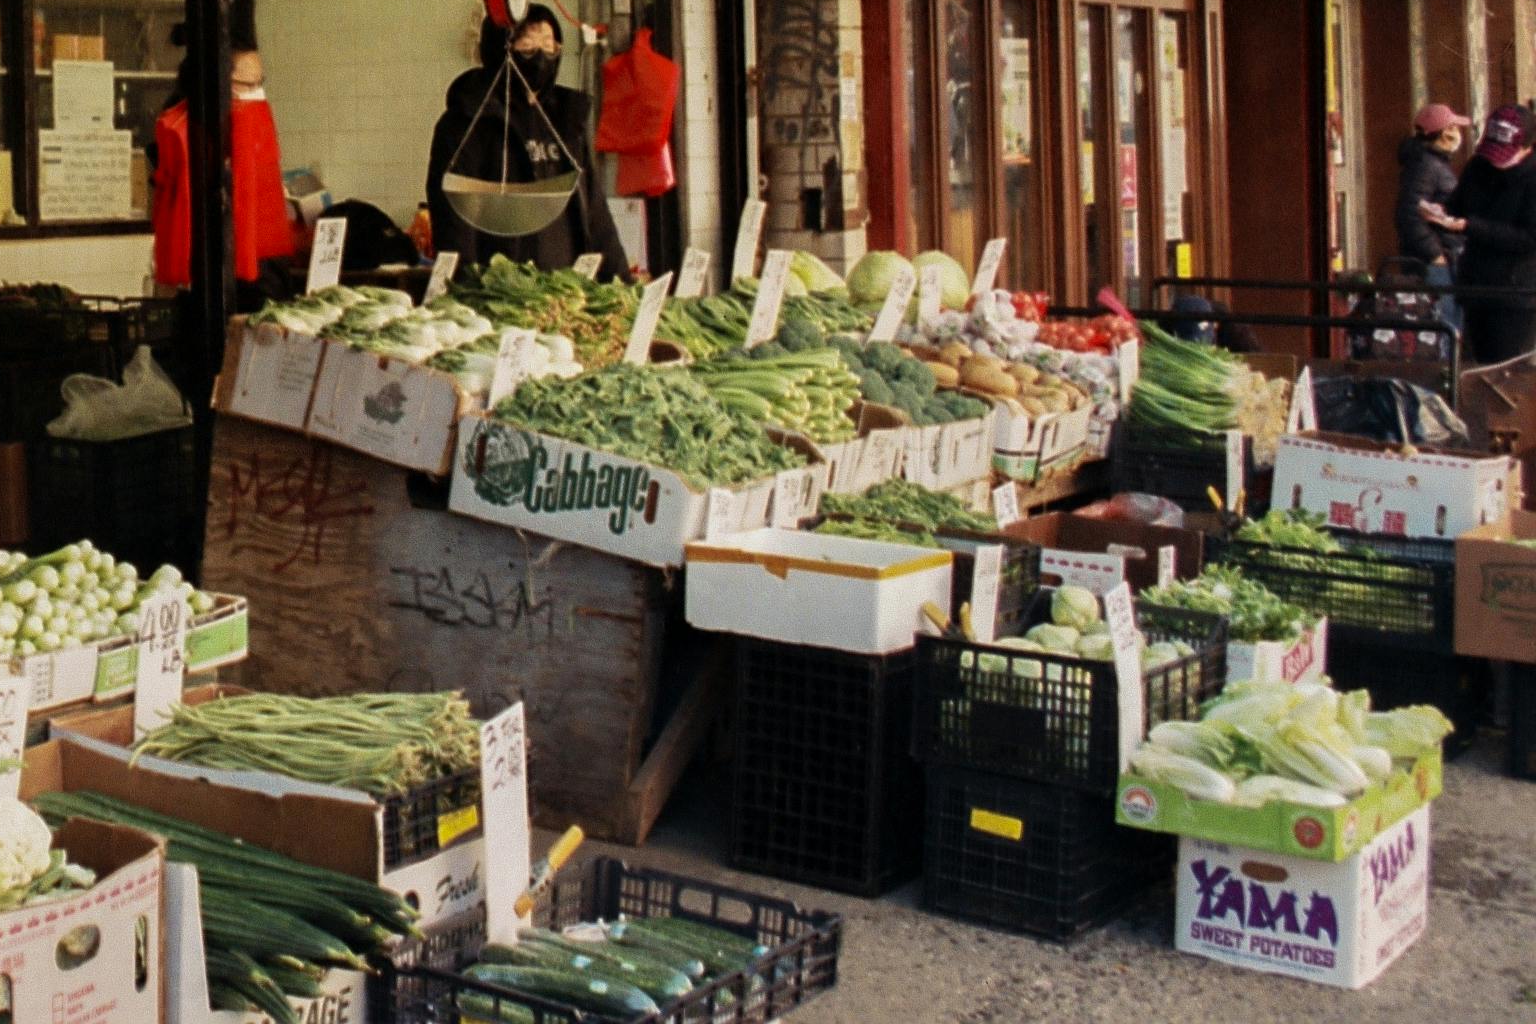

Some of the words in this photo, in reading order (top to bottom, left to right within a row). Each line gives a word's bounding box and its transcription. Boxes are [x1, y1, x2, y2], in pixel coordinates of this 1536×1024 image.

[524, 446, 649, 535] Cabbage
[1190, 859, 1340, 947] YAMA
[1191, 920, 1244, 950] SWEET
[1249, 933, 1336, 969] POTATOES
